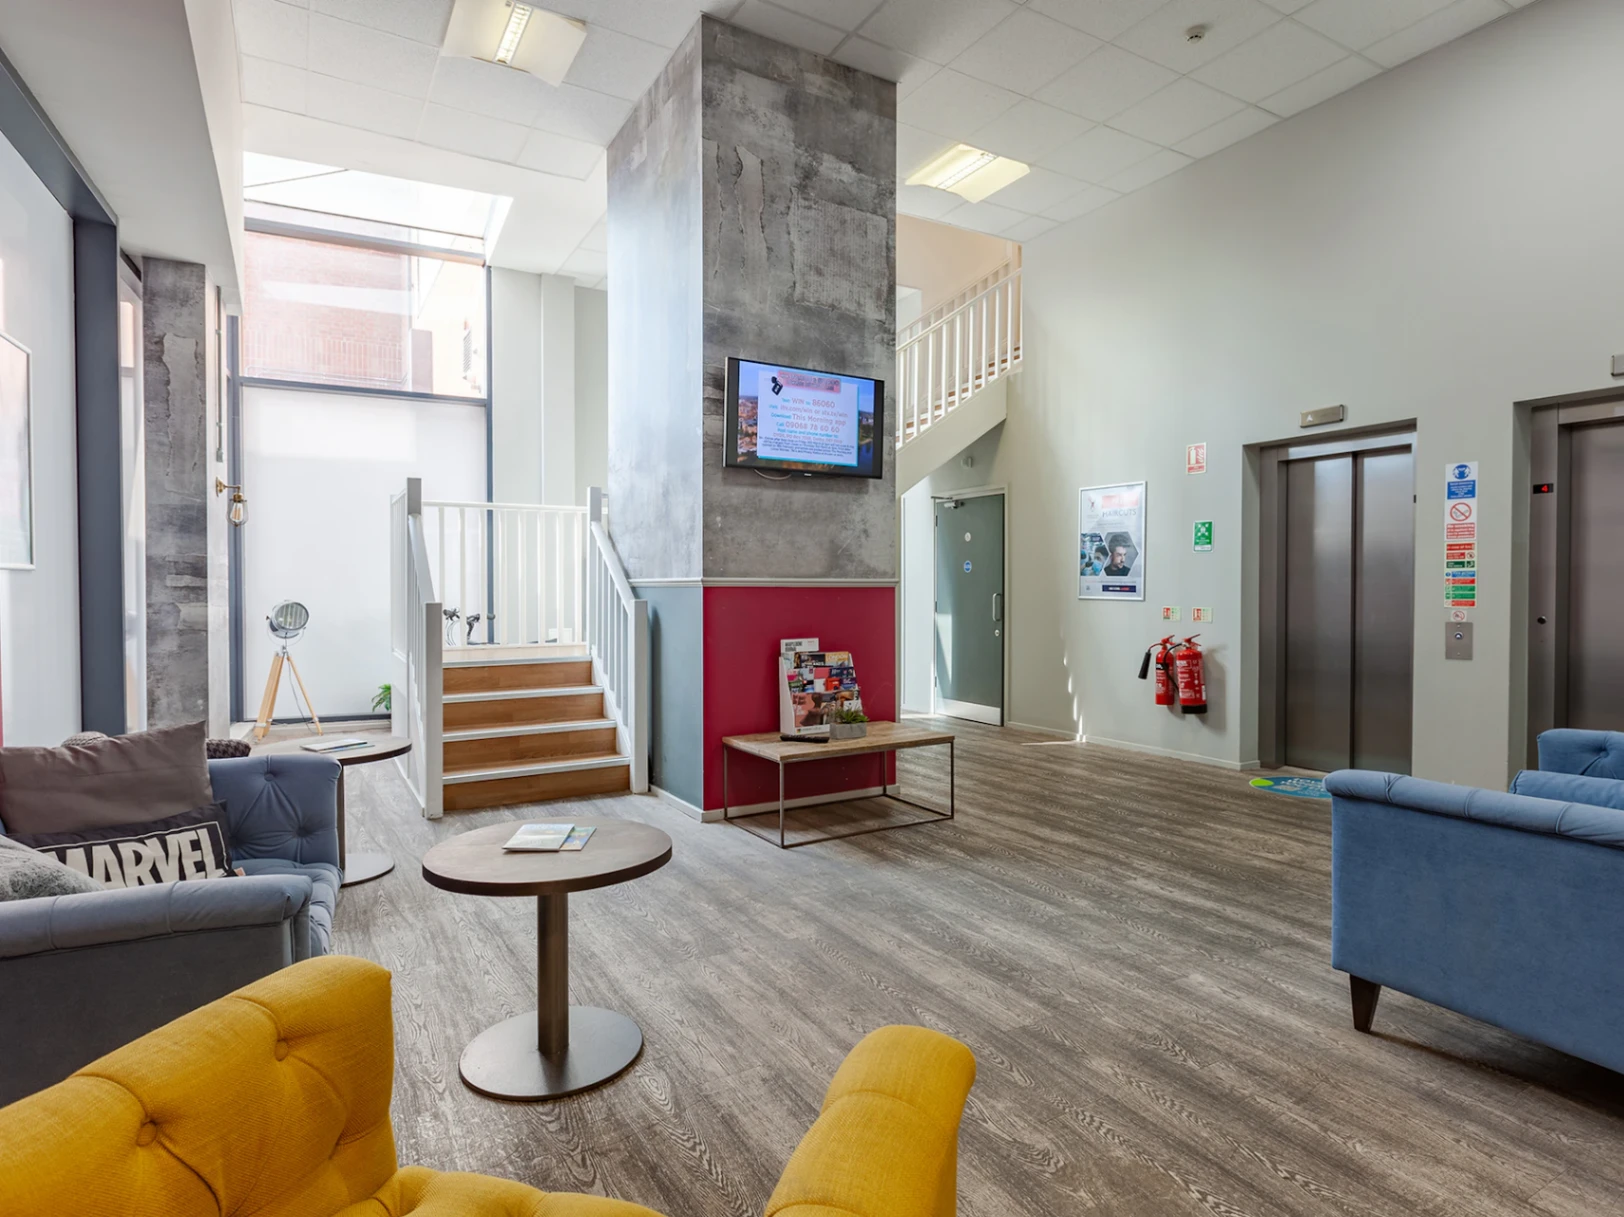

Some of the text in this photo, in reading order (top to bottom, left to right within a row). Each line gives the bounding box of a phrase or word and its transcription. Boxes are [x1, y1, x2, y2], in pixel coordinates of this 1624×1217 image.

[812, 399, 835, 408] 86060
[792, 413, 806, 421] This
[808, 416, 833, 425] Morning
[1102, 508, 1137, 518] HAIRCUTS
[45, 828, 228, 890] MARVEL
